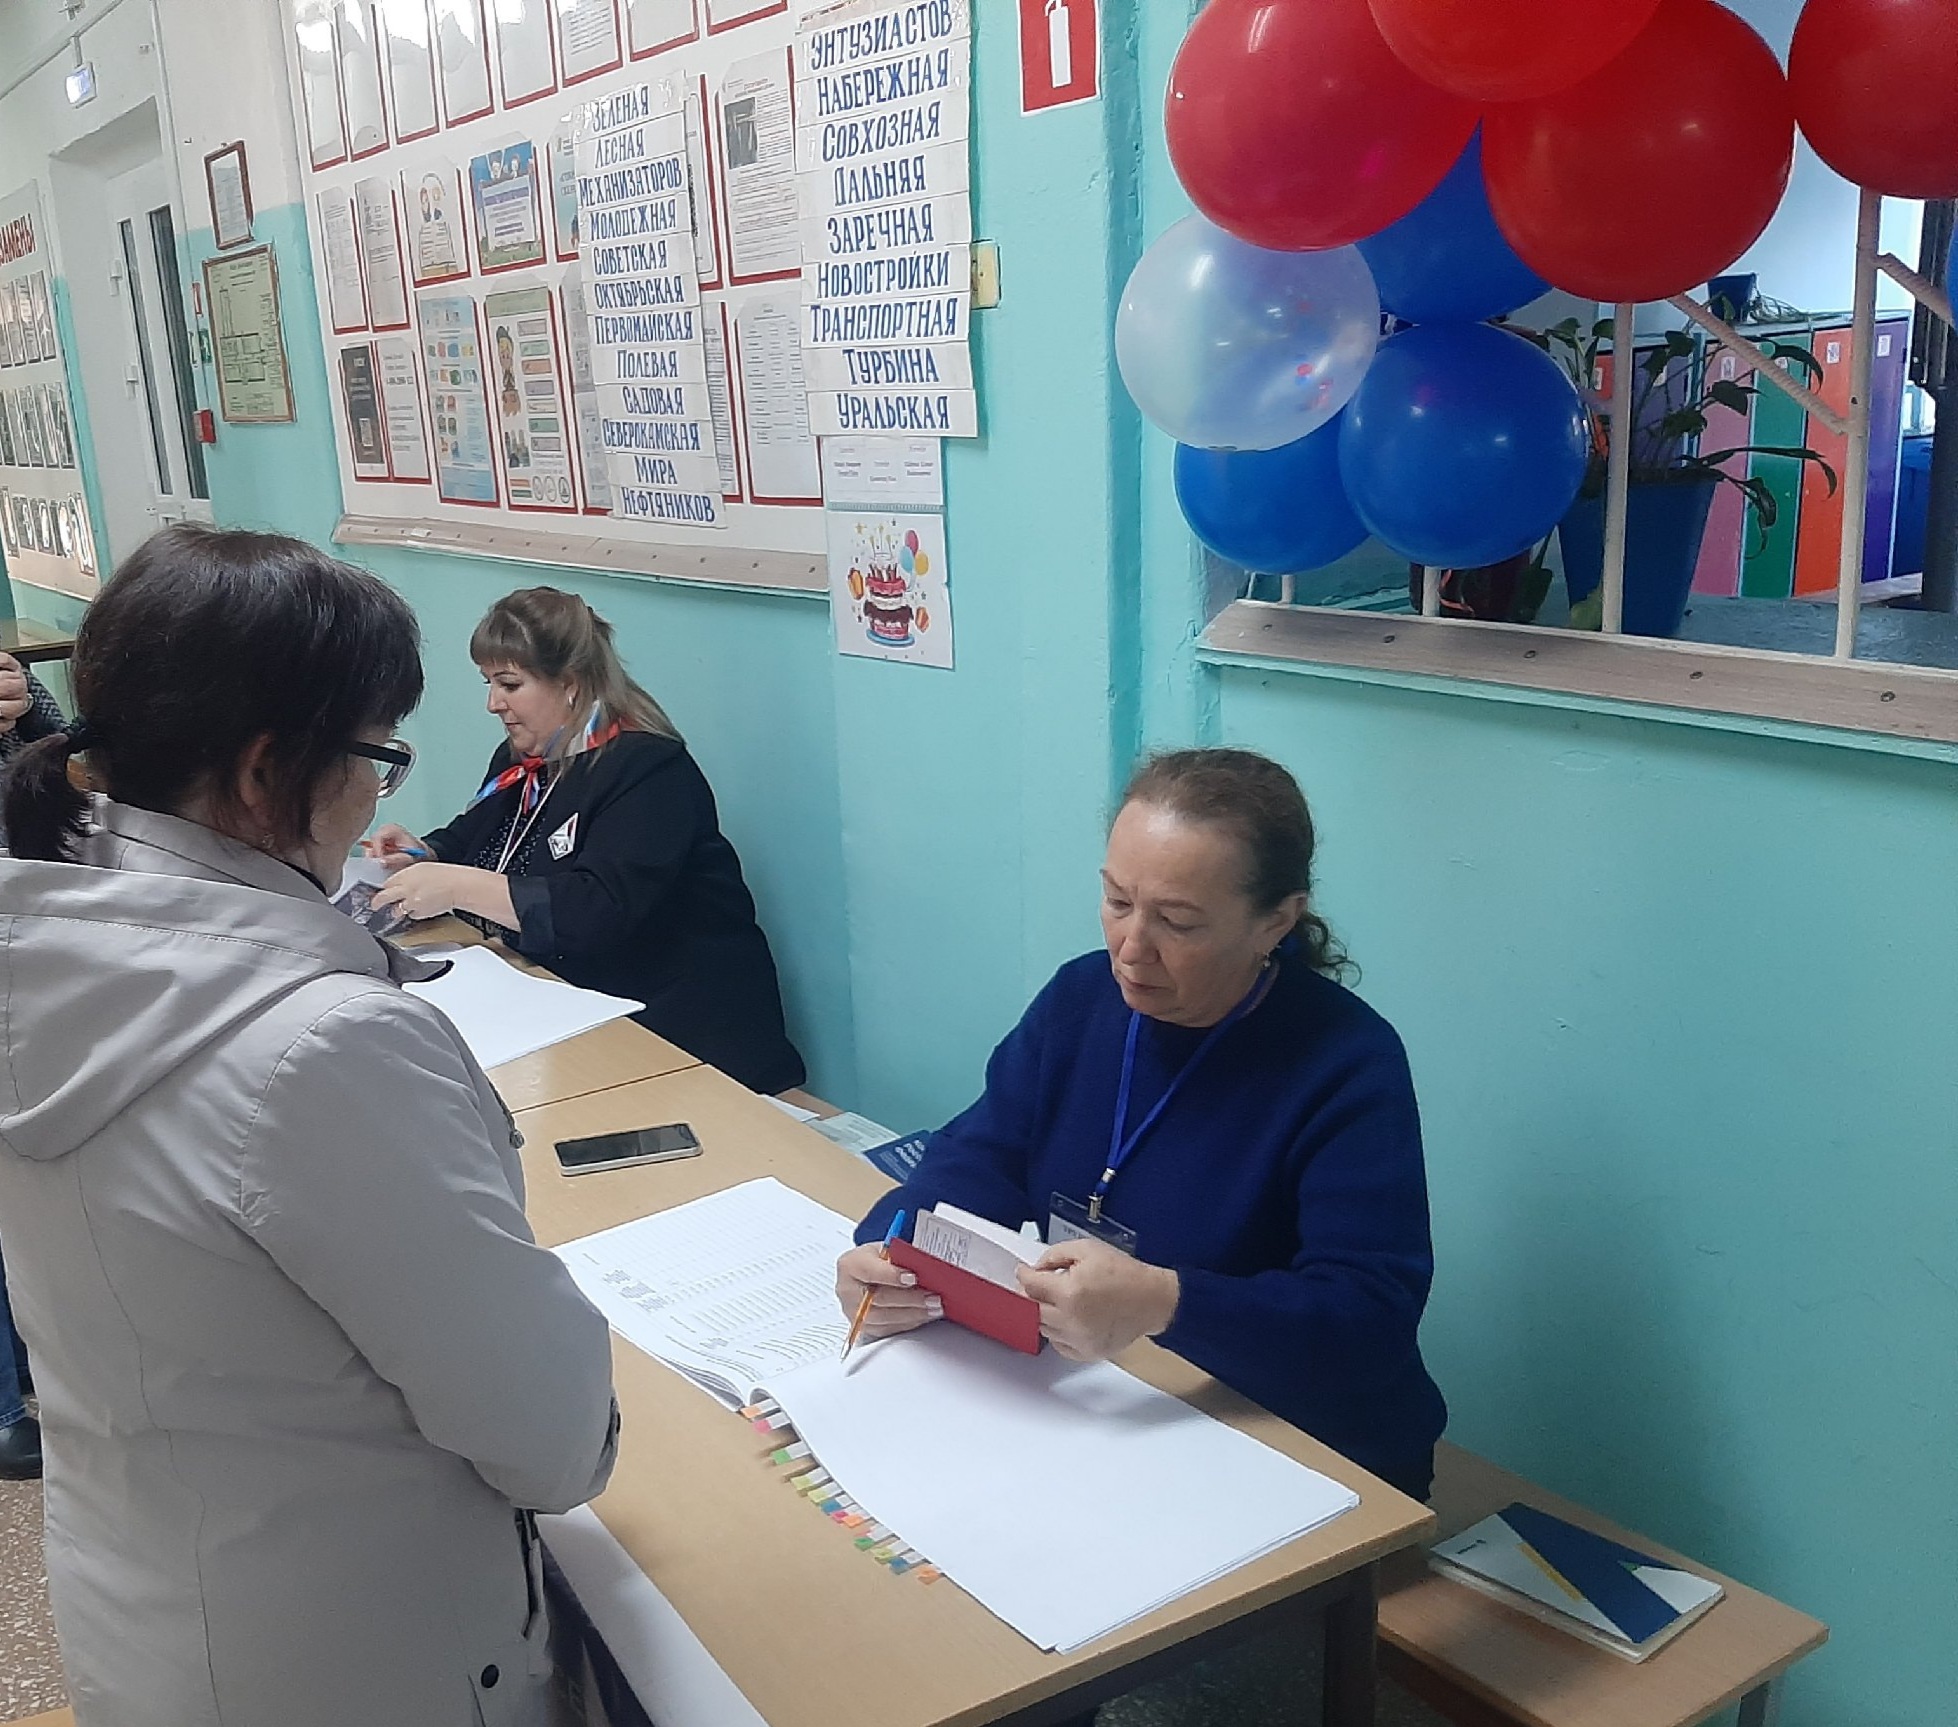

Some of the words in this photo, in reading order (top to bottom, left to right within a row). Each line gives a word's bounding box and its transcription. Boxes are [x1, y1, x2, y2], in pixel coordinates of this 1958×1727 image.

[811, 0, 953, 71] ЭНТУЗИАСТОВ
[816, 47, 950, 117] НАБЕРЕЖНАЯ
[592, 85, 650, 133] ЗЕЛЕНАЯ
[594, 128, 646, 169] ЛЕСНАЯ
[821, 100, 942, 163] СОВХОЗНАЯ
[578, 157, 683, 208] МЕХАНИЗАТОРОВ
[834, 154, 927, 207] ДАЛЬНЯЯ
[590, 199, 677, 242] МОЛОДЕЖНАЯ
[827, 203, 935, 255] ЗАРЕЧНАЯ
[593, 239, 668, 276] СОВЕТСКАЯ
[816, 250, 951, 299] НОВОСТРОЙКИ
[594, 275, 685, 310] ОКТЯБРЬСКАЯ
[810, 297, 959, 343] ТРАНСПОРТНАЯ
[617, 349, 679, 379] ПОЛЕВАЯ
[842, 347, 940, 386] ТУРБИНА
[622, 385, 685, 416] САДОВАЯ
[836, 392, 951, 430] УРАЛЬСКАЯ
[602, 418, 701, 451] СЕВЕРОКАМСКАЯ
[634, 455, 678, 485] МИРА
[621, 486, 716, 523] НЕФТЯНИКОВ
